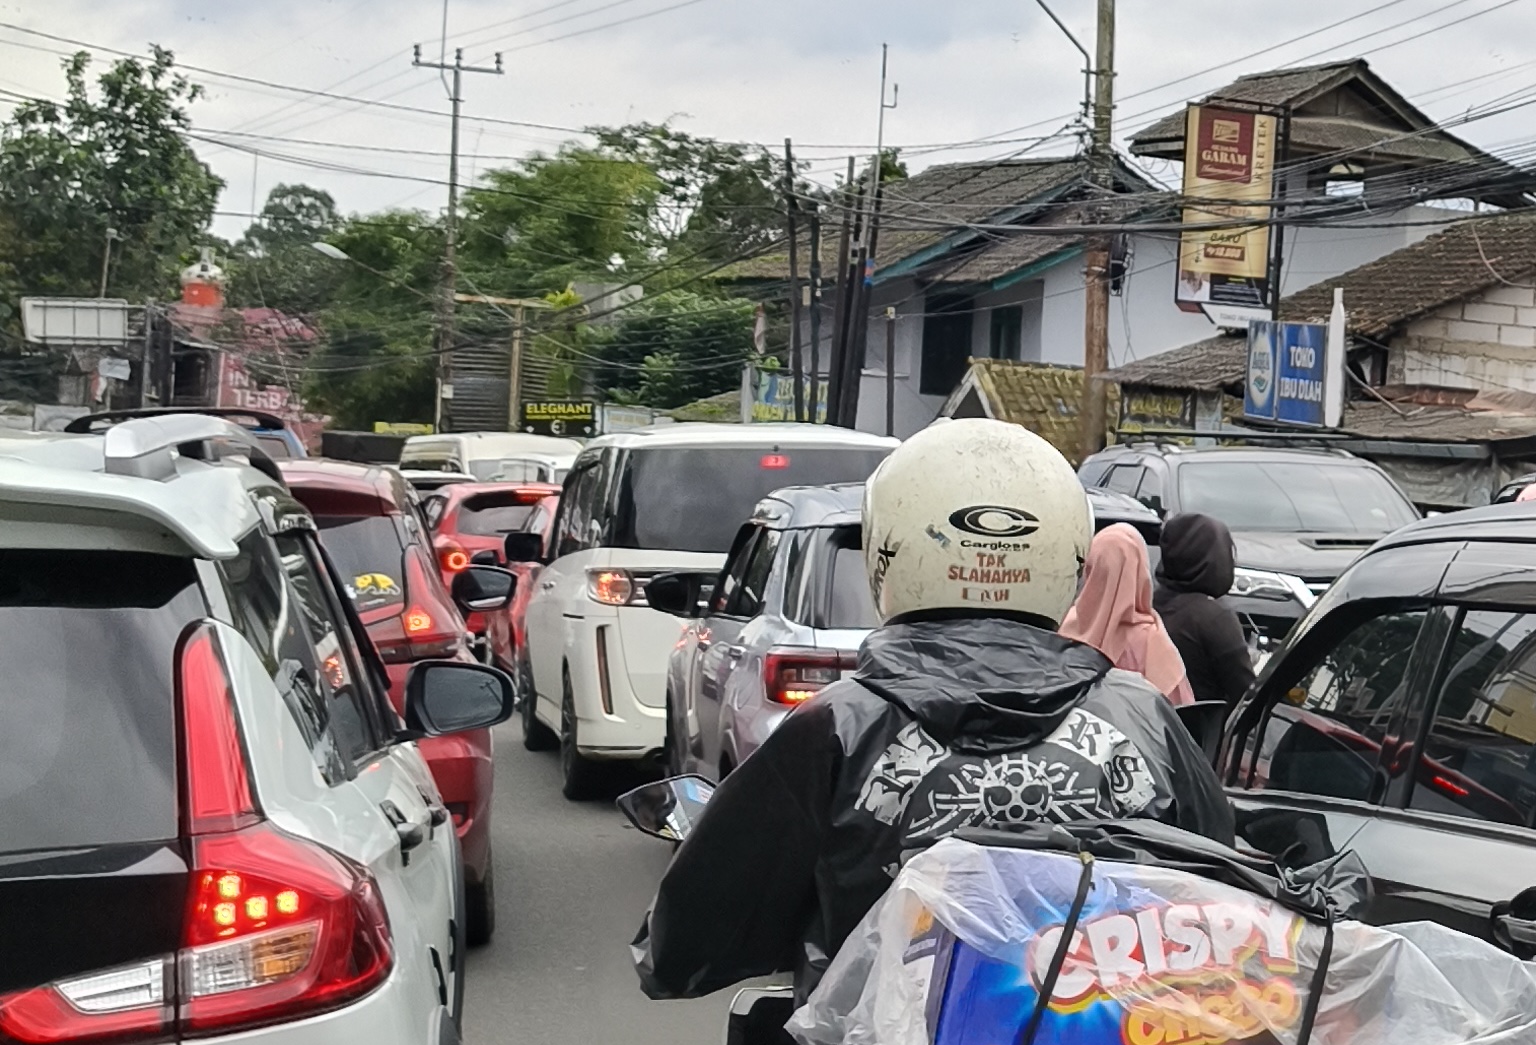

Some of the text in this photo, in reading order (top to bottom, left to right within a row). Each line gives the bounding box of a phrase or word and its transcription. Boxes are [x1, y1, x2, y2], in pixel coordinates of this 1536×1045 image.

[1202, 150, 1247, 166] GARAM
[1290, 346, 1315, 368] TOKO
[1280, 377, 1323, 402] IBU DIAH
[960, 539, 1031, 551] Cargloss
[976, 552, 1007, 569] TAK
[1030, 901, 1300, 999] CRISPY
